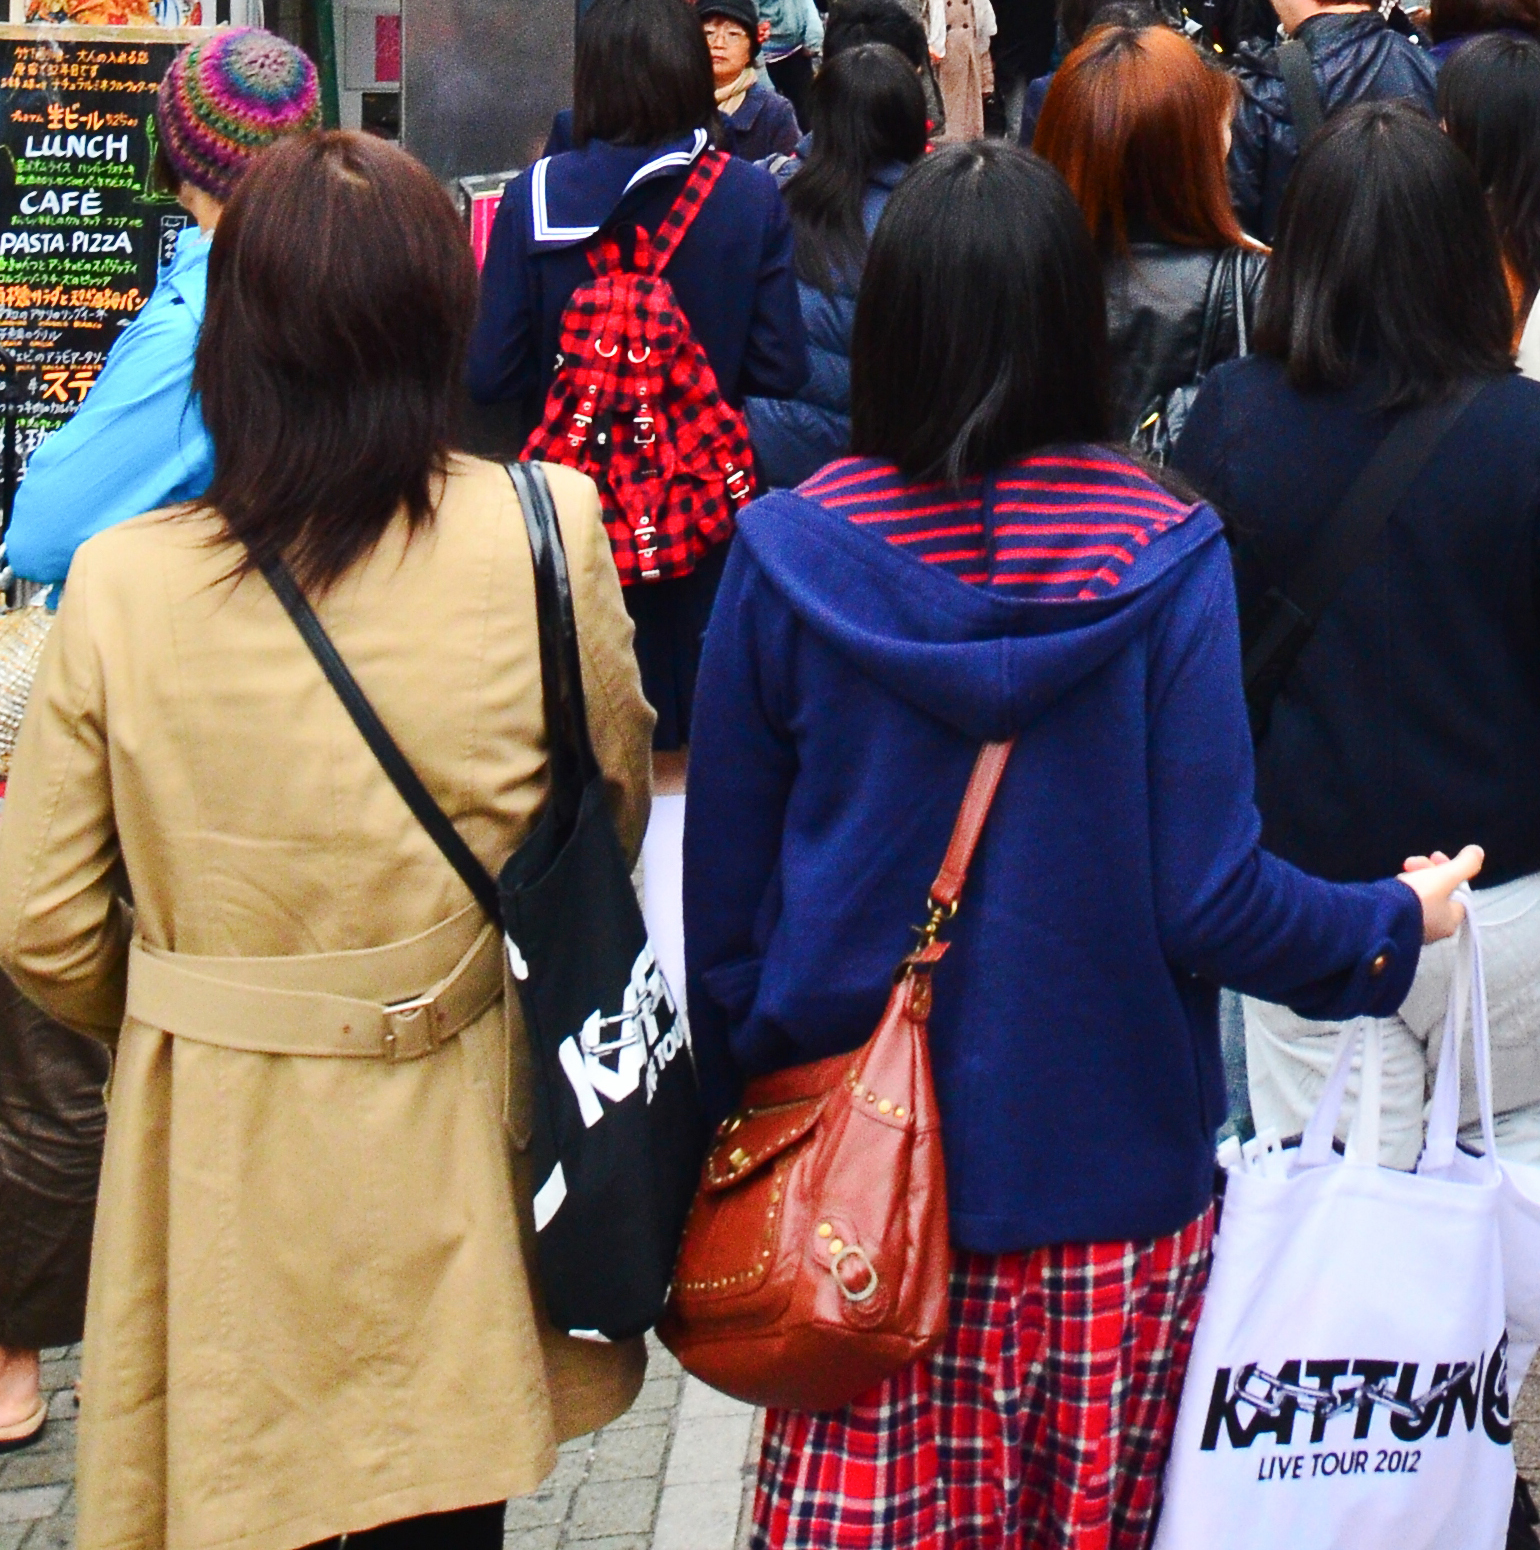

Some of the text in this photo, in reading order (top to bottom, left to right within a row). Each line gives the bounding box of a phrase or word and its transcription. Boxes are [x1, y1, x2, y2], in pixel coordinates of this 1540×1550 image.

[46, 102, 104, 131] 生ビール
[24, 133, 129, 164] LUNCH
[1257, 1448, 1423, 1481] LIVE TOUR 2012
